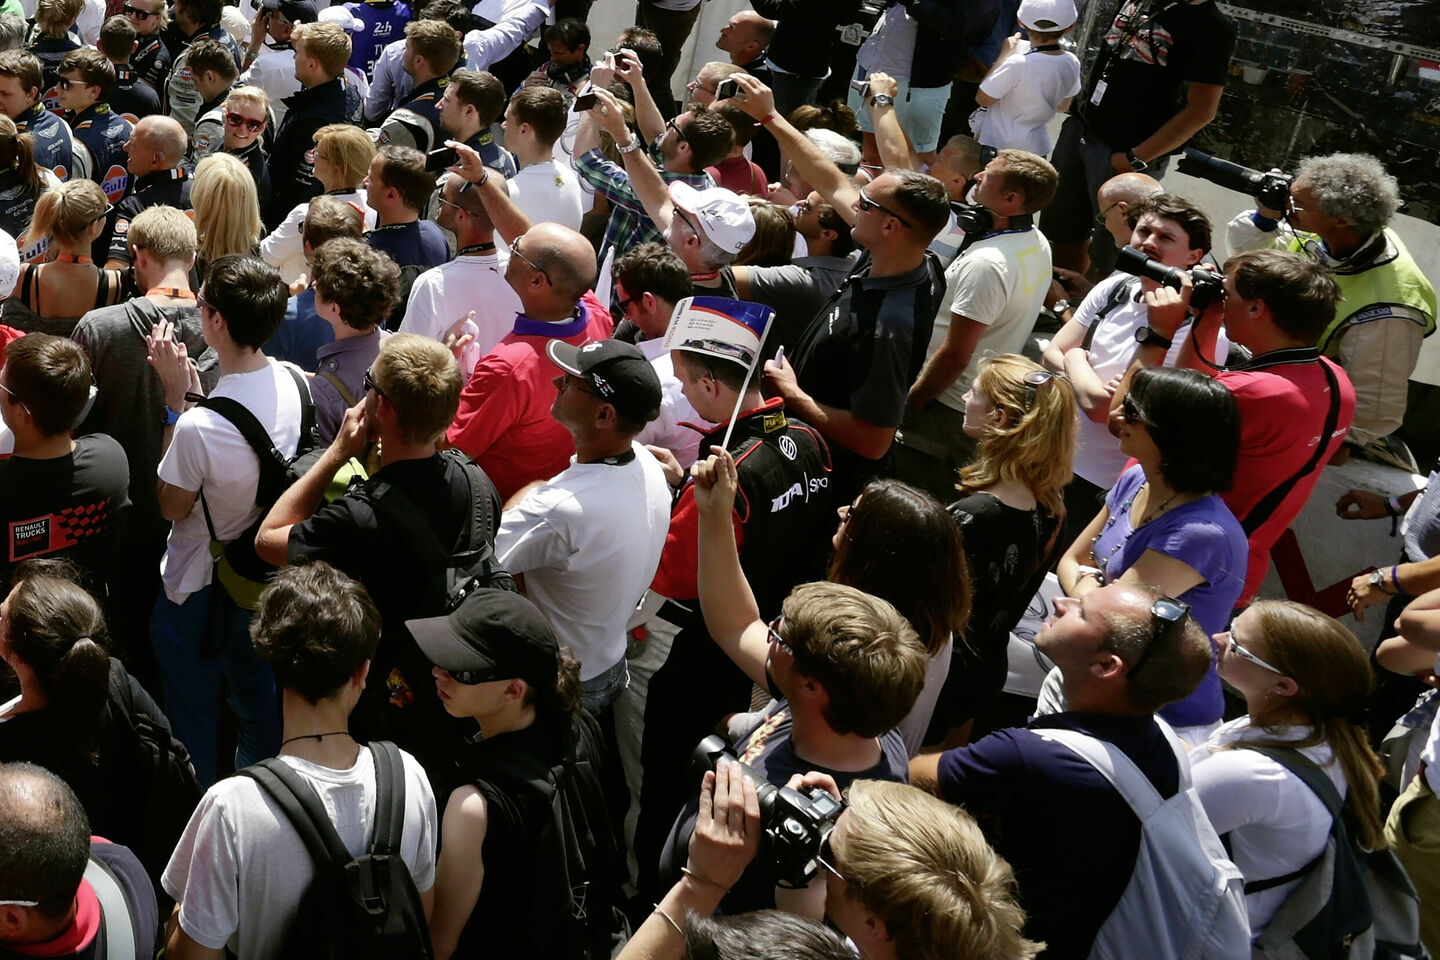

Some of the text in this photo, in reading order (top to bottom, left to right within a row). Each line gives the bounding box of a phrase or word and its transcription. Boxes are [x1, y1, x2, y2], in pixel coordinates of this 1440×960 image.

[374, 20, 392, 34] 24h
[102, 176, 128, 194] Gulf
[16, 520, 46, 533] RENAULT
[16, 527, 46, 540] TRUCKS
